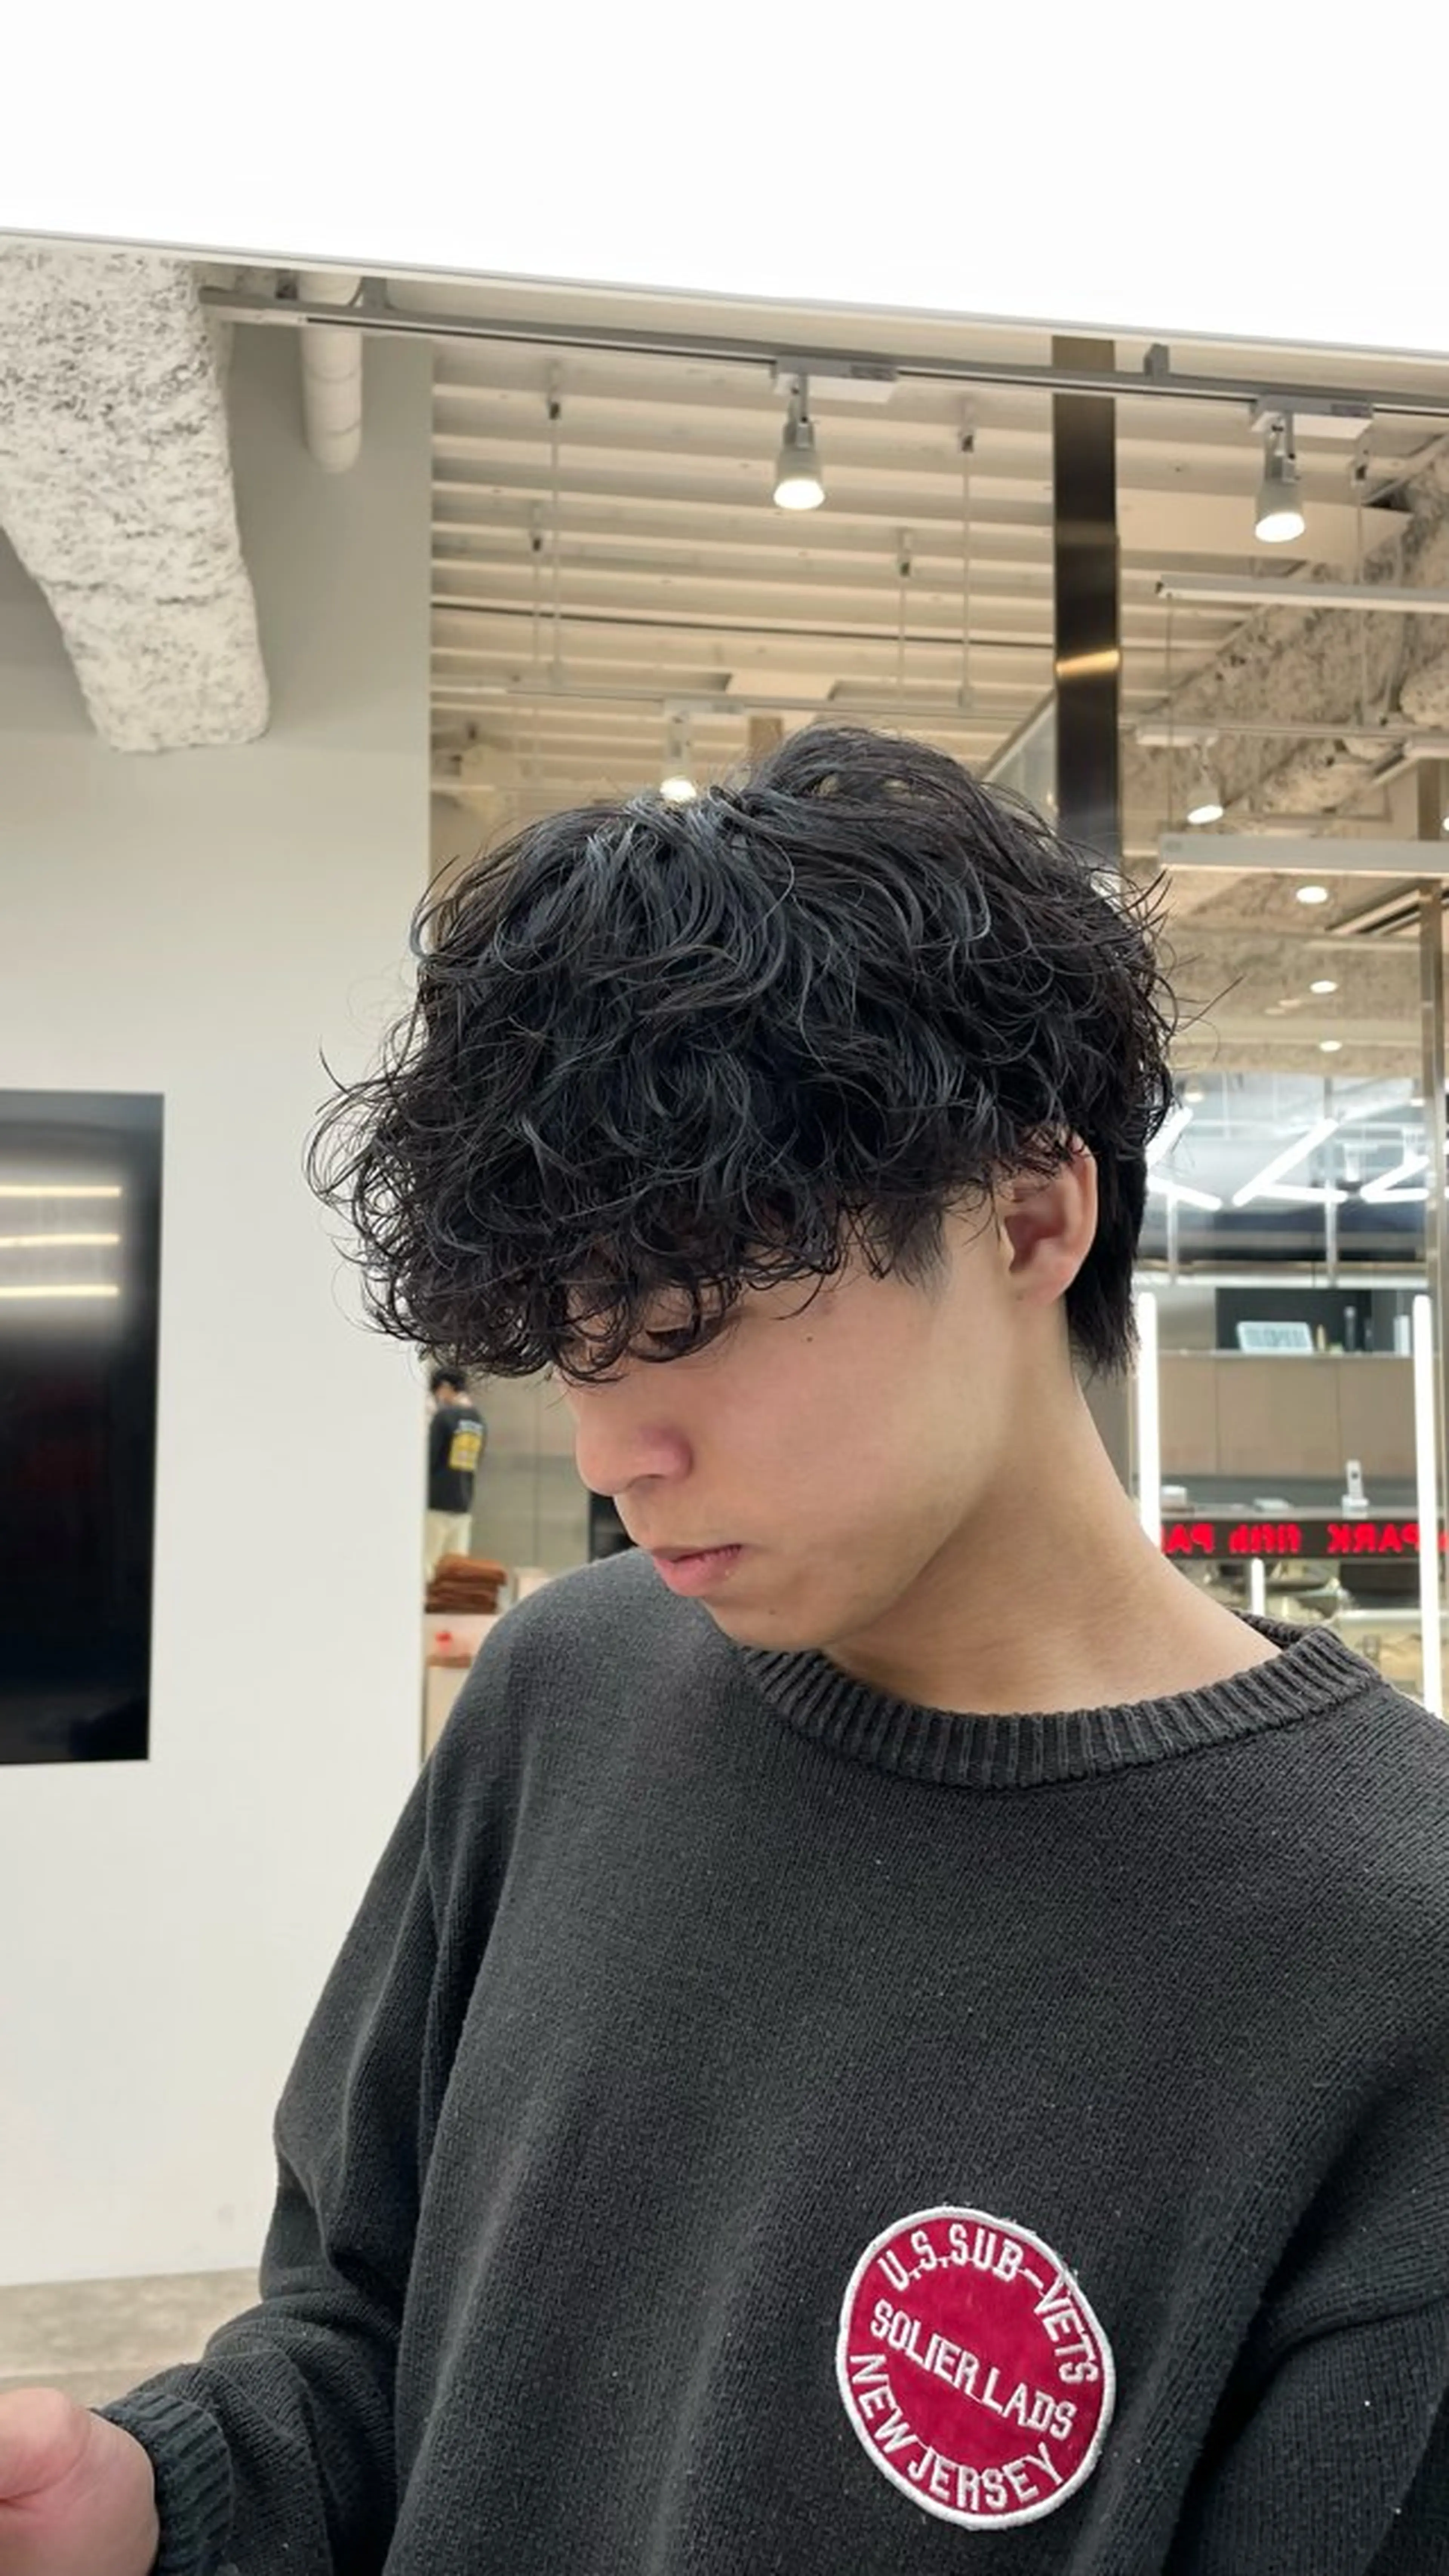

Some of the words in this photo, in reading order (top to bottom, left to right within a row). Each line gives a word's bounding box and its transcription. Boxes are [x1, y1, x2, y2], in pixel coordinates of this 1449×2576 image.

[851, 2354, 918, 2454] NEW
[908, 2441, 1063, 2510] JERSEY
[870, 2299, 982, 2404] SOLIER
[982, 2367, 1077, 2439] LADS
